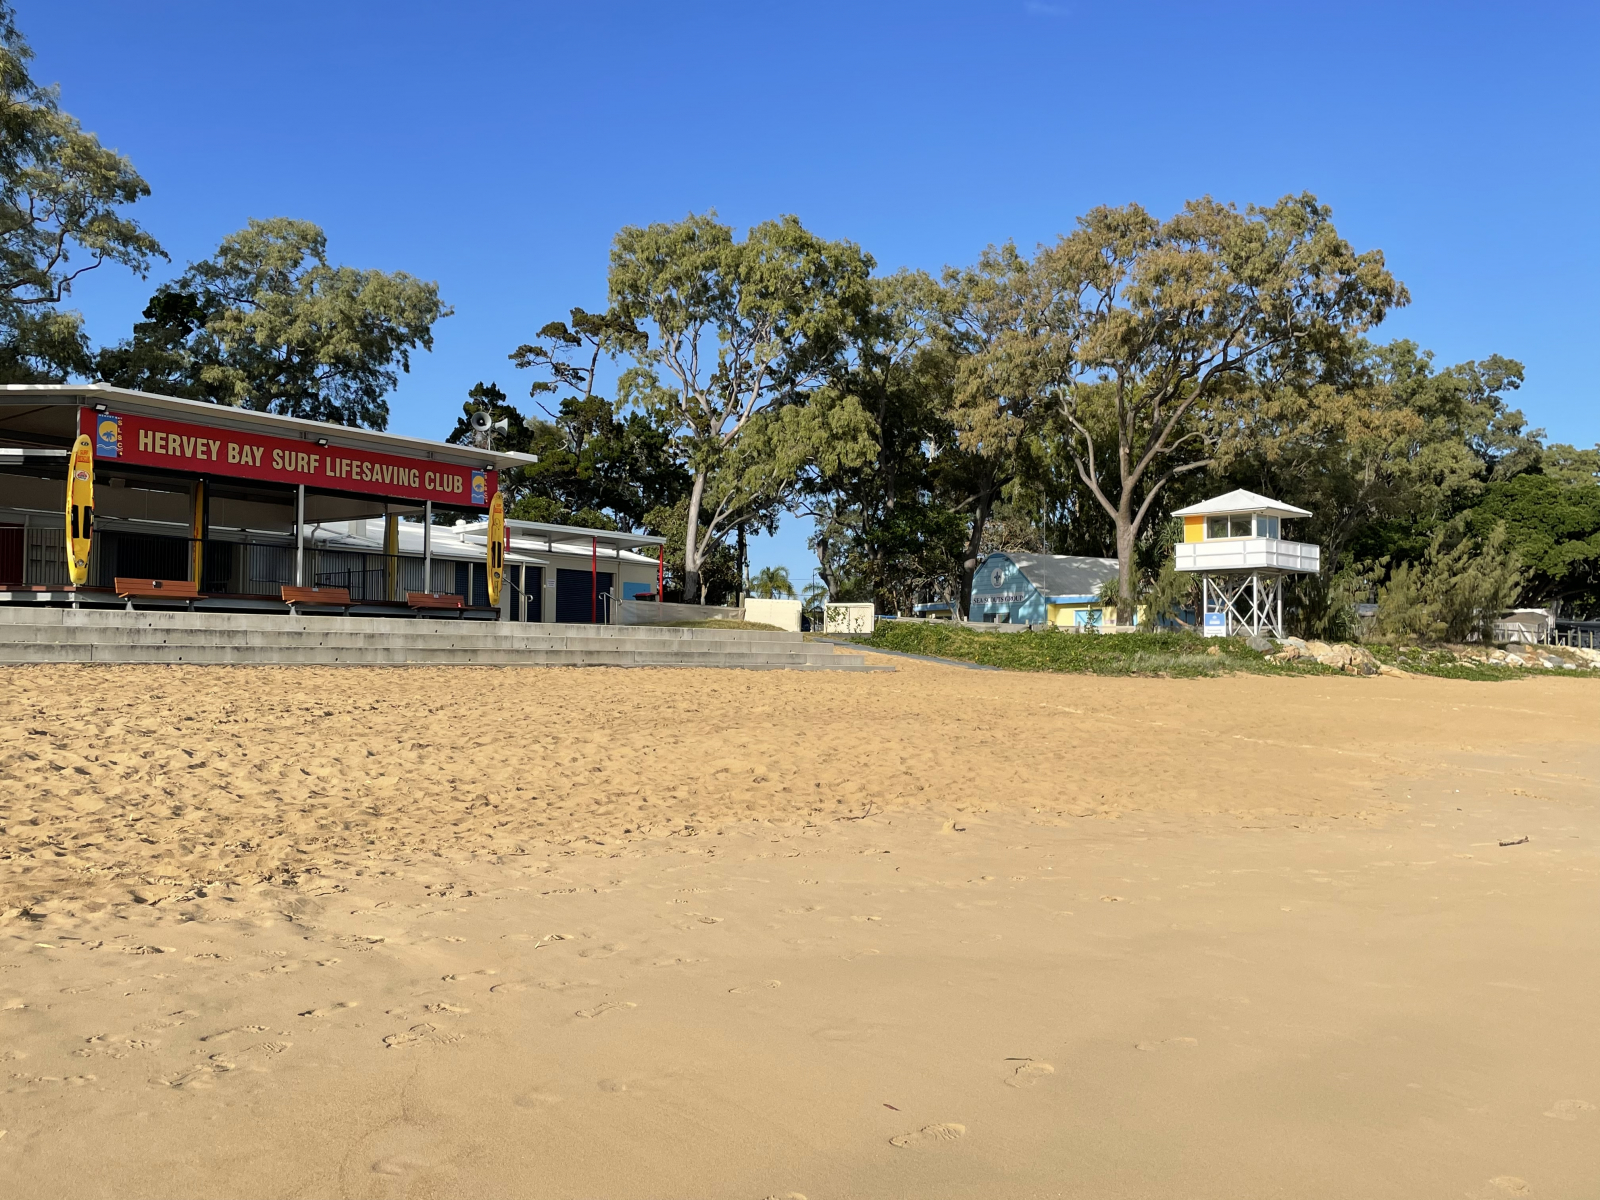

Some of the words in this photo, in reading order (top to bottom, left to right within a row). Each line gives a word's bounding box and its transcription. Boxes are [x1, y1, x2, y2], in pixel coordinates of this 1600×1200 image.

[138, 429, 221, 461] HERVEY
[227, 442, 265, 467] BAY
[272, 449, 320, 474] SURF
[326, 456, 420, 488] LIFESAVING
[425, 471, 464, 493] CLUB
[1004, 594, 1024, 602] GROUP
